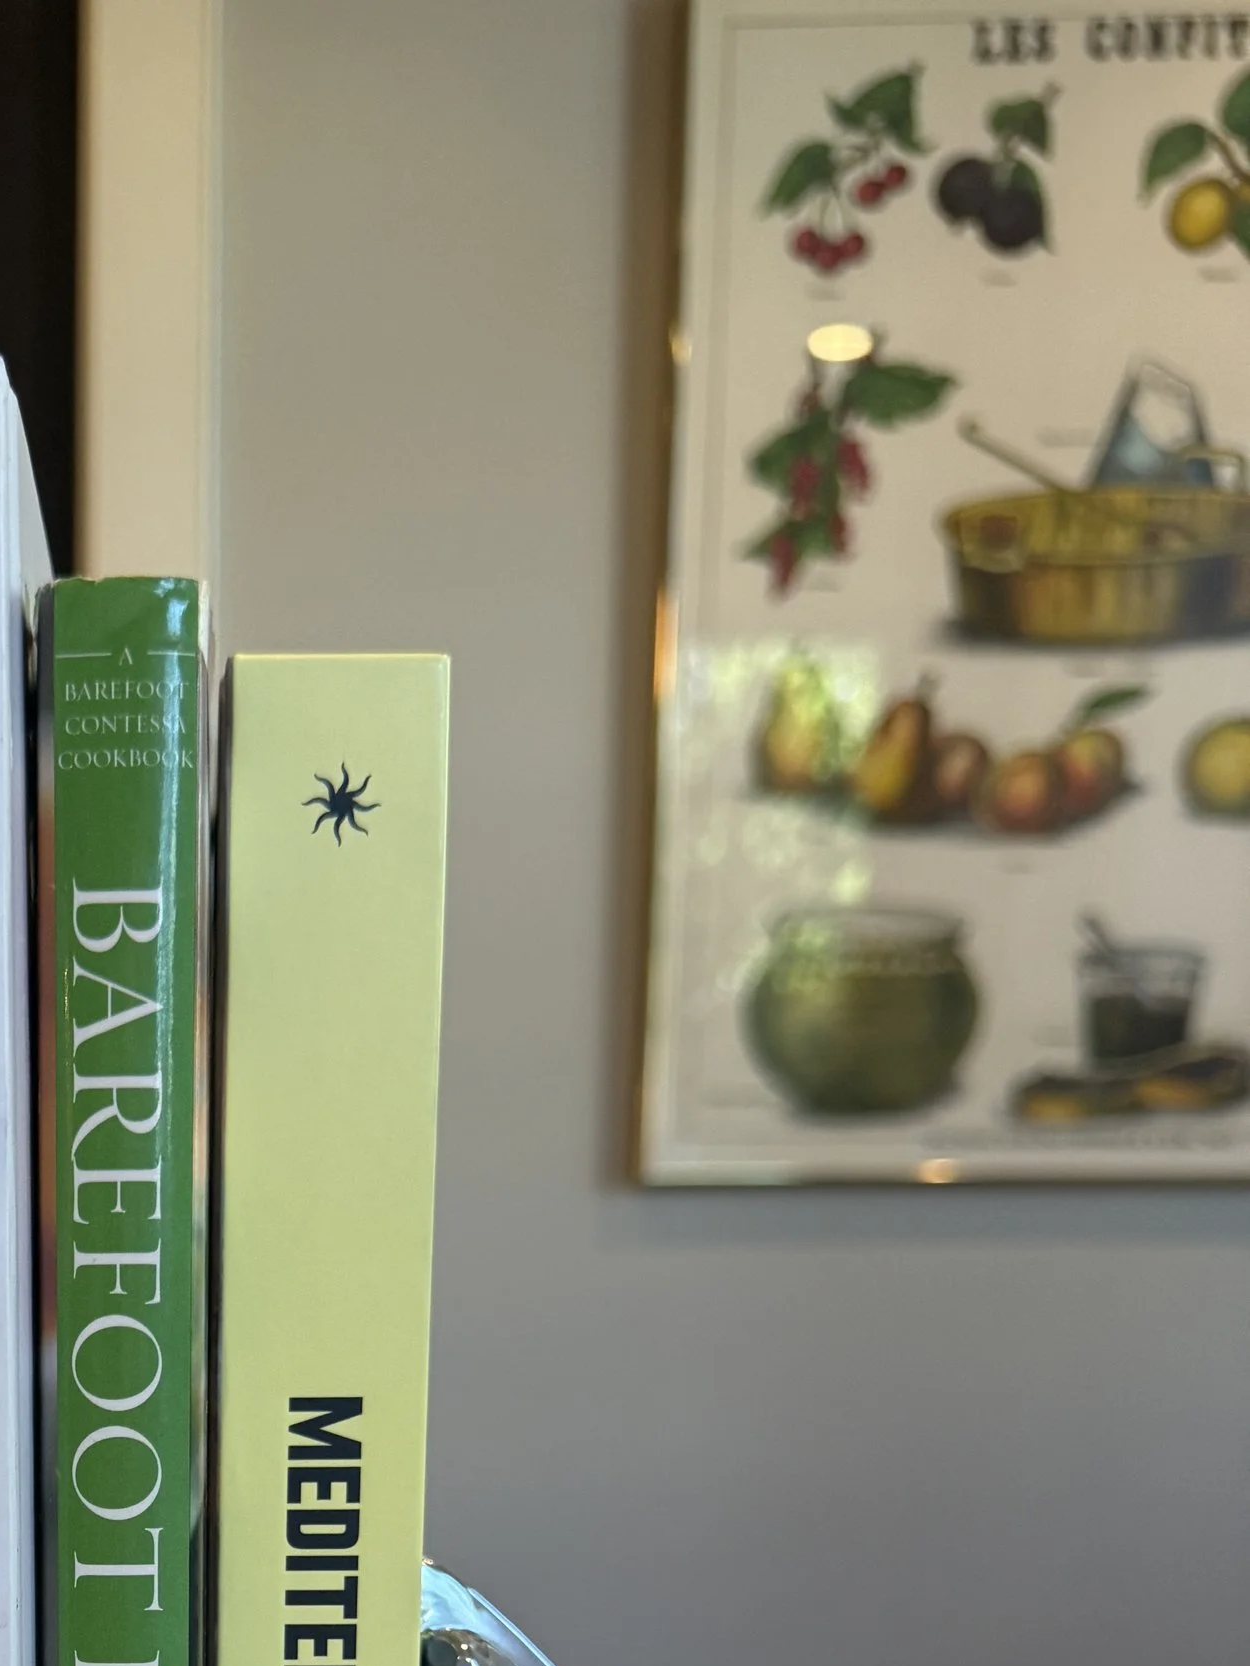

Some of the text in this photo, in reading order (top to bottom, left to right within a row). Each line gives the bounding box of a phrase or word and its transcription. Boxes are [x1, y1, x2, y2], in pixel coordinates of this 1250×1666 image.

[971, 18, 1055, 64] LES
[119, 645, 134, 665] A
[65, 680, 190, 701] BAREFOOT
[65, 714, 186, 735] CONTESSA
[58, 748, 195, 770] COOKBOOK
[71, 877, 163, 1612] BAREFOOT
